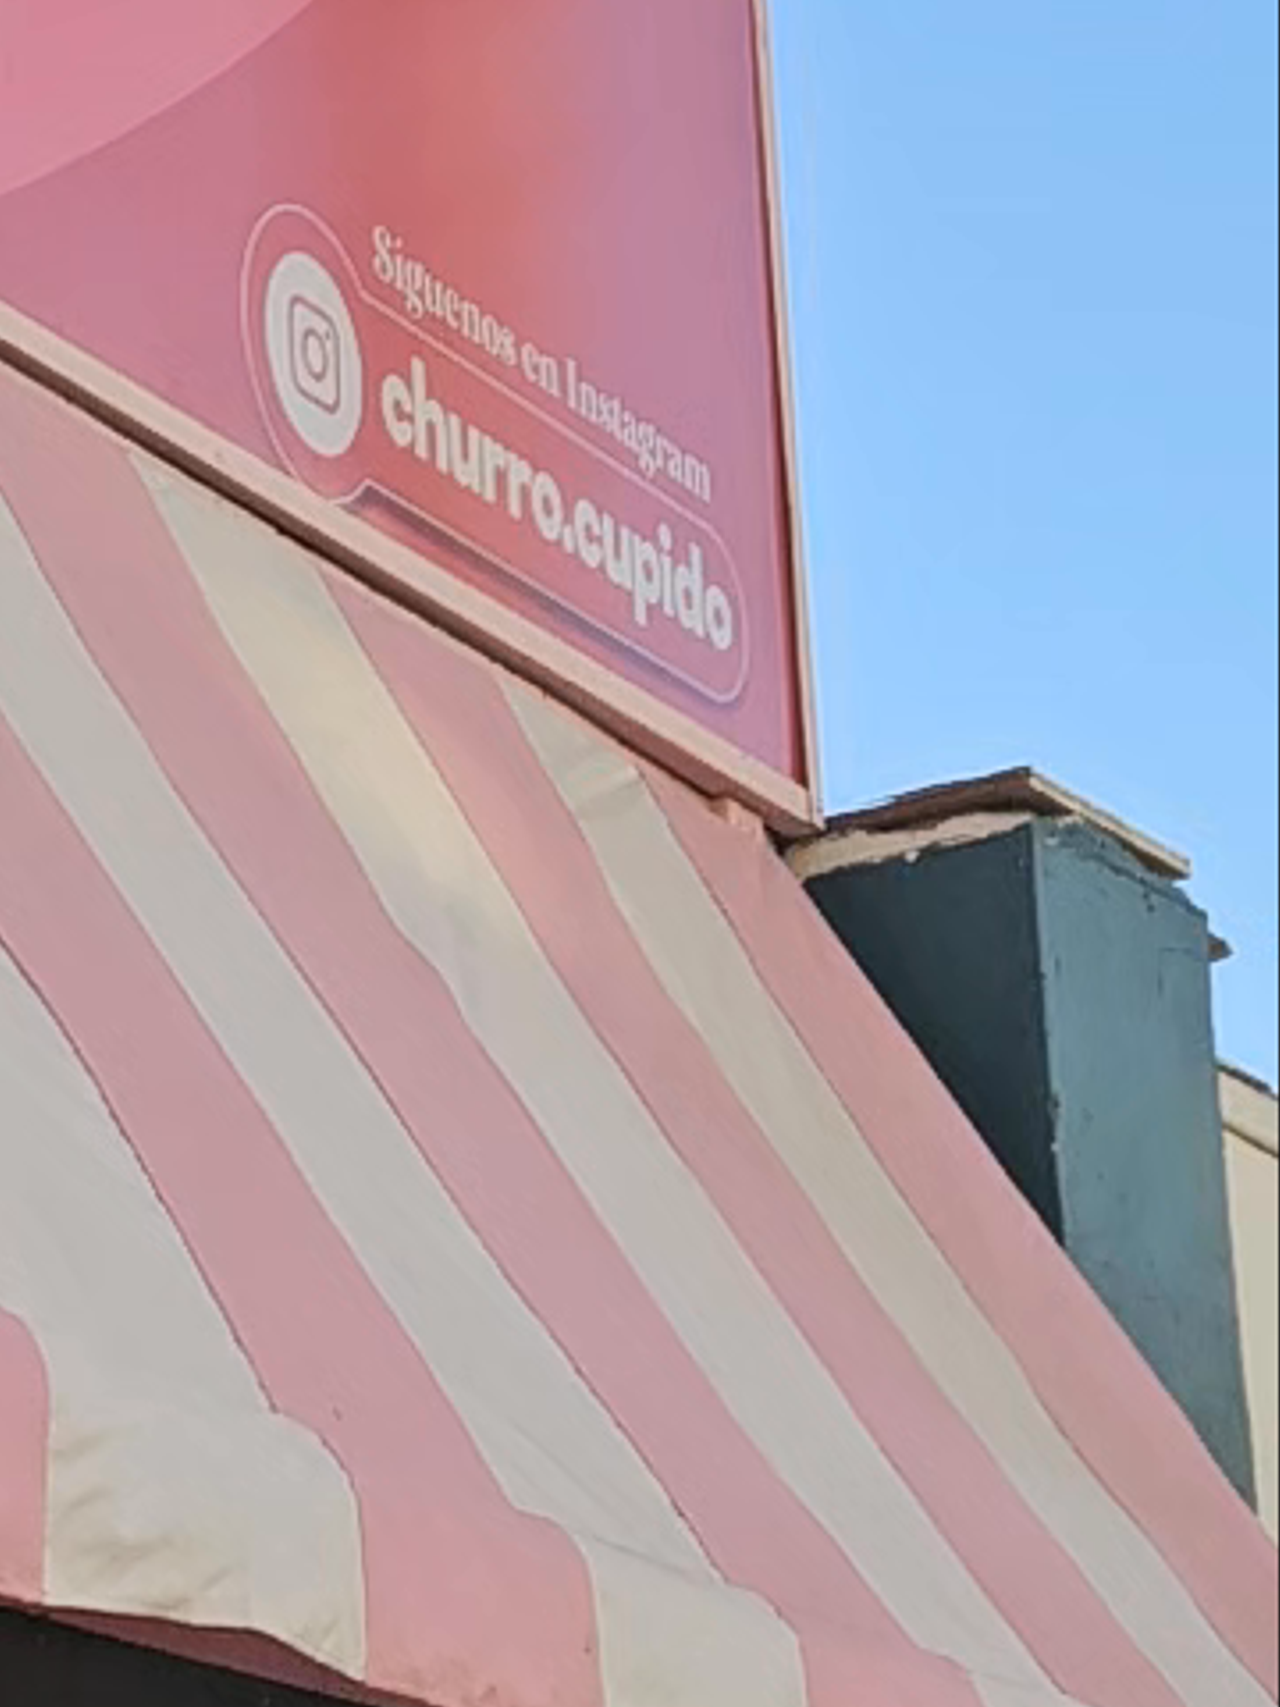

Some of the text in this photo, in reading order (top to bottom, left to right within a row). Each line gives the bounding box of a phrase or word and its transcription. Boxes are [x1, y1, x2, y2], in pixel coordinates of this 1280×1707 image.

[380, 356, 733, 652] churro.cupido
[520, 340, 560, 398] en
[566, 358, 711, 503] Instagram
